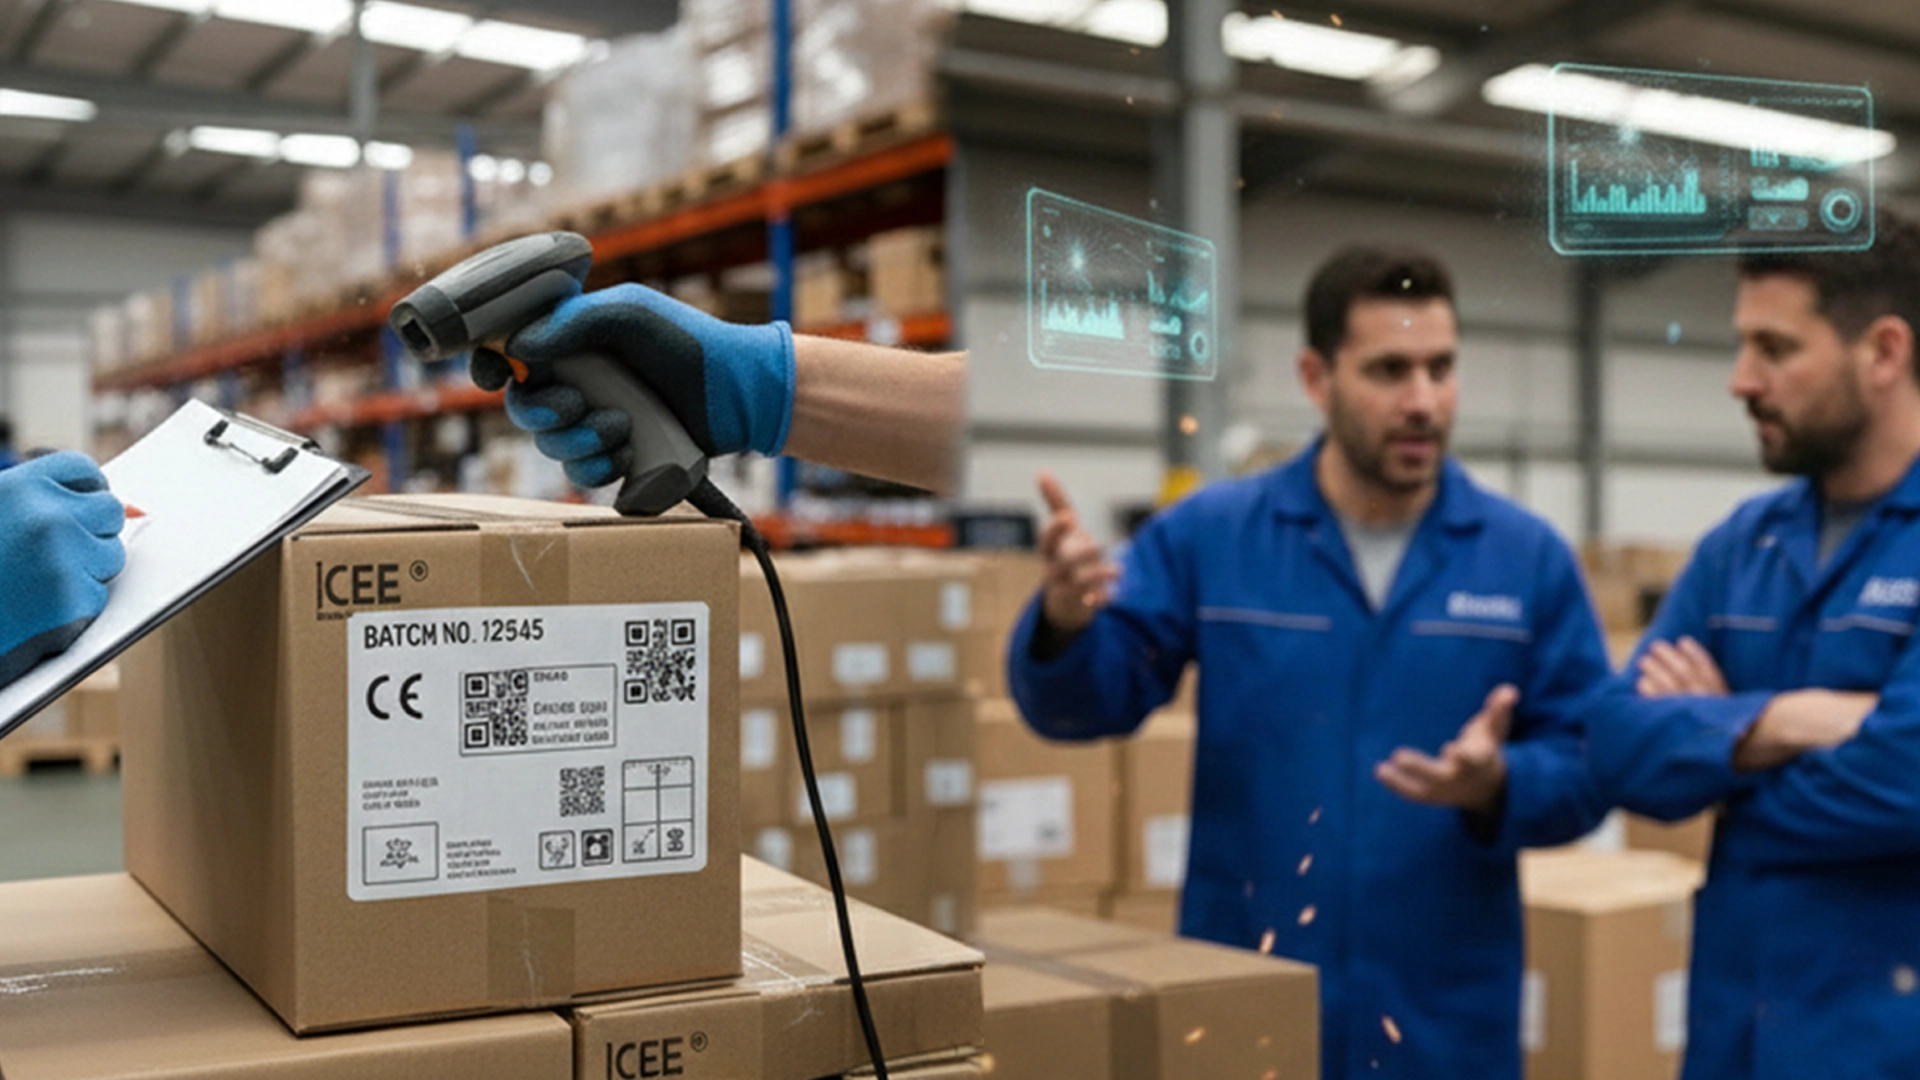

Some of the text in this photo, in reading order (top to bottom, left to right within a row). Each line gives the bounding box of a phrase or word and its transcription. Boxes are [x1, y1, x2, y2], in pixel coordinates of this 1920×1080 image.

[442, 621, 477, 645] NO.
[481, 618, 545, 647] 12545
[366, 672, 423, 720] CE
